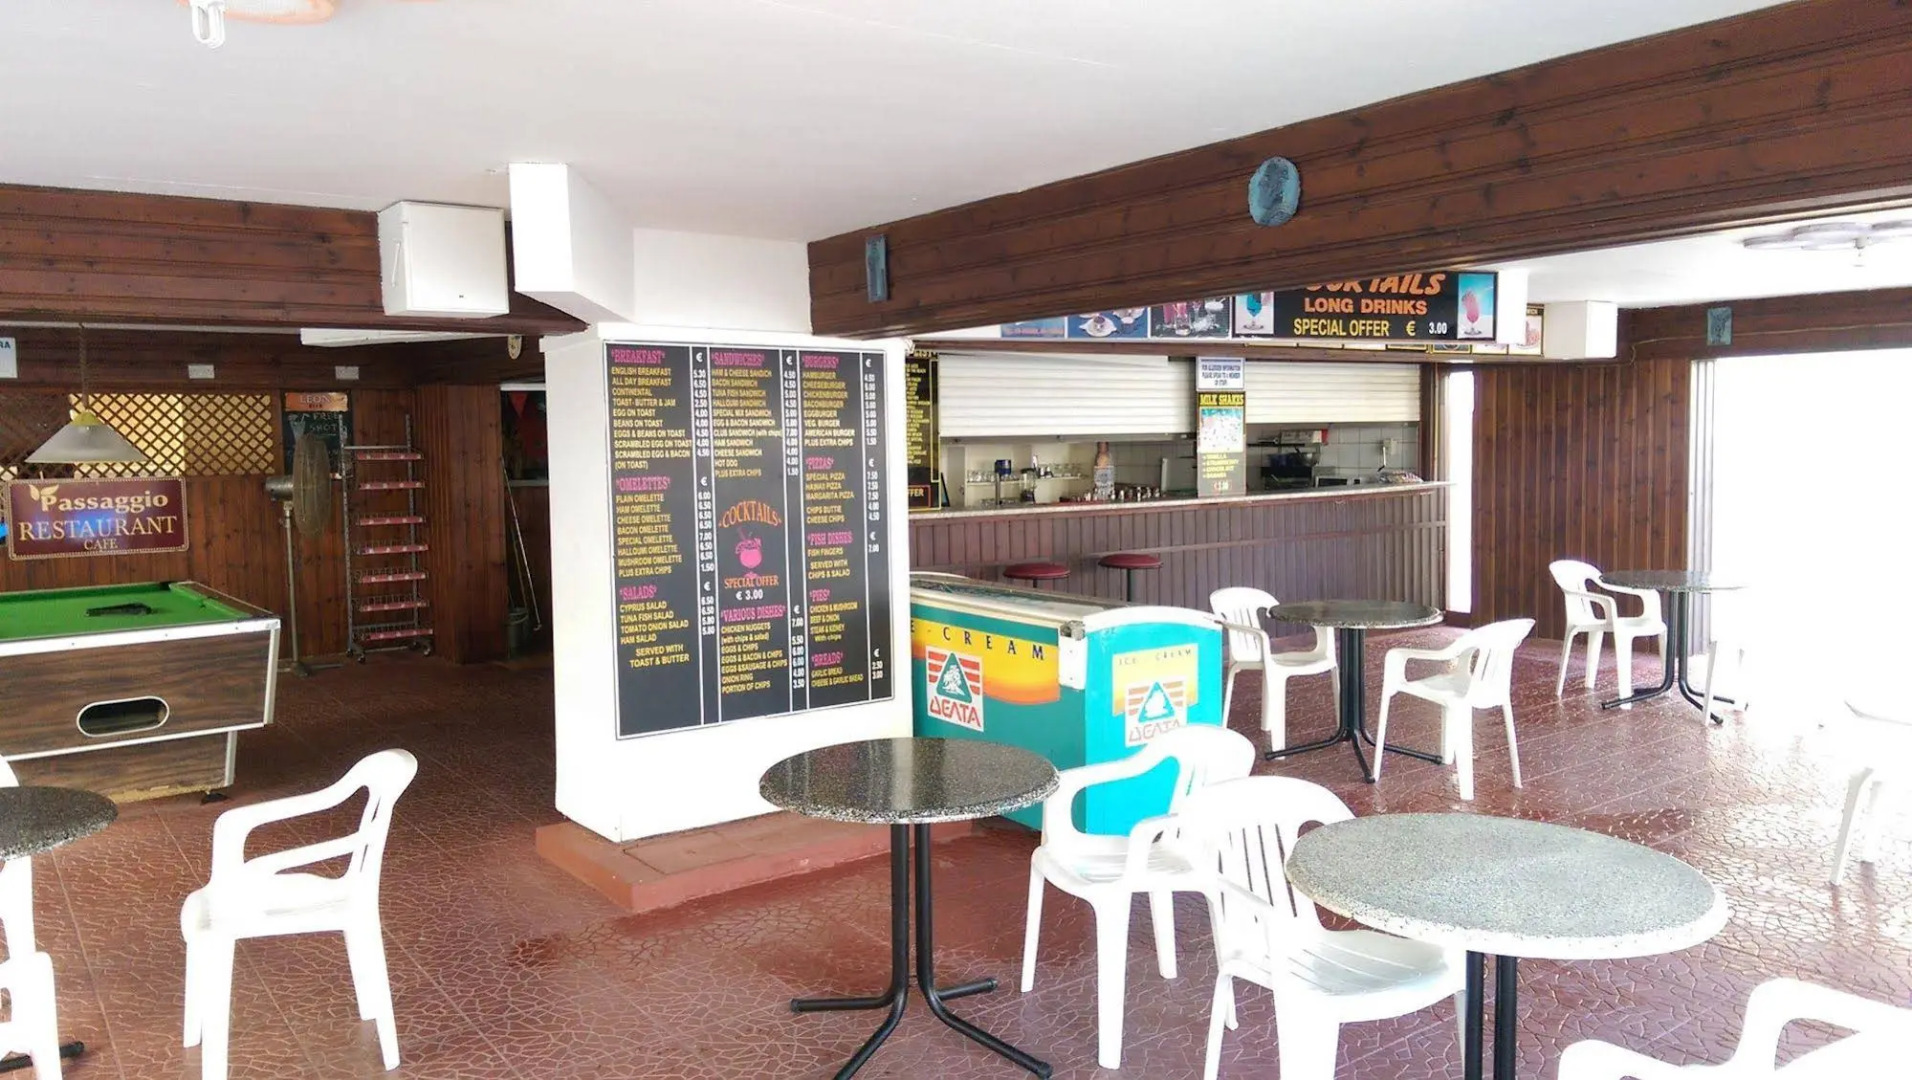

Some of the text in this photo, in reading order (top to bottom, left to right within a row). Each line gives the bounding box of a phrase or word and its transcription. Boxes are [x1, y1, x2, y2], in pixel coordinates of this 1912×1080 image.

[1304, 298, 1428, 315] LONG DRINKS
[1294, 318, 1447, 336] SPECIAL OFFER € 3.00
[696, 352, 703, 362] €
[786, 356, 792, 365] €
[612, 366, 672, 376] ENGLISH BREAKFAST
[612, 378, 672, 386] ALL DAY BREAKFAST
[612, 388, 652, 396] CONTINENTAL
[1200, 394, 1244, 406] MILK SHAKES
[613, 408, 626, 416] EGG
[714, 408, 734, 416] SPECIAL
[613, 420, 663, 428] BEANS ON TOAST
[614, 430, 630, 438] EGGS
[636, 430, 656, 438] BEANS
[614, 440, 692, 448] SCRAMBLED EGG TOAST
[838, 438, 853, 446] CHIPS
[615, 450, 650, 458] SCRAMBLED
[651, 450, 664, 458] EGG
[670, 450, 690, 458] BACON
[627, 461, 648, 470] TOAST)
[830, 472, 845, 480] PIZZA
[700, 477, 708, 486] €
[40, 490, 169, 514] Passaggio
[616, 494, 664, 503] PLAIN OMELETTE
[616, 504, 660, 513] HAM OMELETTE
[806, 506, 822, 514] CHIPS
[617, 514, 671, 524] CHEESE OMELETTE
[807, 516, 828, 524] CHEESE
[18, 516, 178, 541] RESTAURANT
[618, 524, 669, 534] BACON OMELETTE
[84, 538, 118, 550] CAFE
[618, 535, 672, 545] SPECIAL OMELETTE
[648, 545, 678, 554] OMELETTE
[820, 548, 844, 556] FINGERS
[618, 555, 682, 566] MUSHROOM OMELETTE
[810, 559, 848, 570] SERVED WITH
[618, 566, 672, 577] PLUS EXTRA CHIPS
[808, 569, 850, 580] CHIPS SALAD
[704, 582, 710, 591] €
[724, 574, 779, 589] SPECIAL OFFER
[736, 589, 764, 600] € 3.00
[620, 601, 667, 612] CYPRUS SALAD
[794, 605, 800, 614] €
[810, 605, 828, 614] CHICKEN
[620, 611, 674, 623] TUNA FISH SALAD
[621, 620, 688, 634] TOMATO ONION SALAD
[722, 624, 744, 634] CHICKEN
[746, 622, 770, 631] NUGGETS
[621, 634, 656, 644] HAM SALAD
[944, 627, 1044, 660] CREAM
[636, 644, 684, 656] SERVED WITH
[722, 643, 758, 654] EGGS CHIPS
[630, 654, 690, 668] TOAST BUTTER
[722, 650, 782, 664] EGGS BACON CHIPS
[722, 659, 788, 674] EGGS CHIPS
[812, 667, 842, 678] GARLIC BREAD
[722, 675, 739, 684] ONION
[812, 674, 864, 688] CHEESE BREAD
[722, 681, 770, 694] PORTION CHIPS
